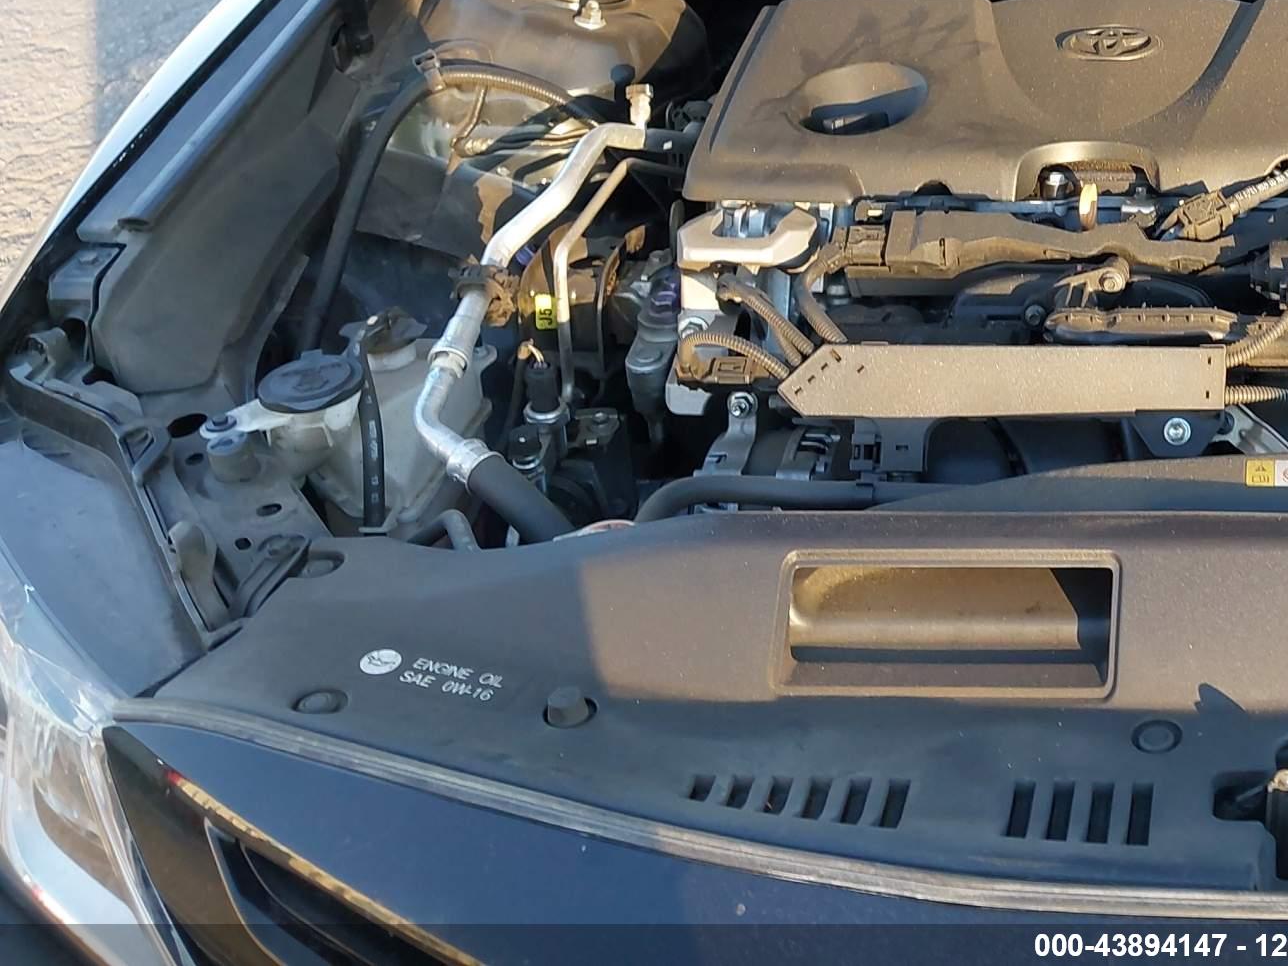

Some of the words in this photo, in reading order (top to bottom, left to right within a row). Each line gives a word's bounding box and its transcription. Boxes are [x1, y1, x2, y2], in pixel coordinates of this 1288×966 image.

[399, 670, 437, 688] SAE
[412, 656, 474, 680] ENGINE
[478, 672, 504, 688] OIL
